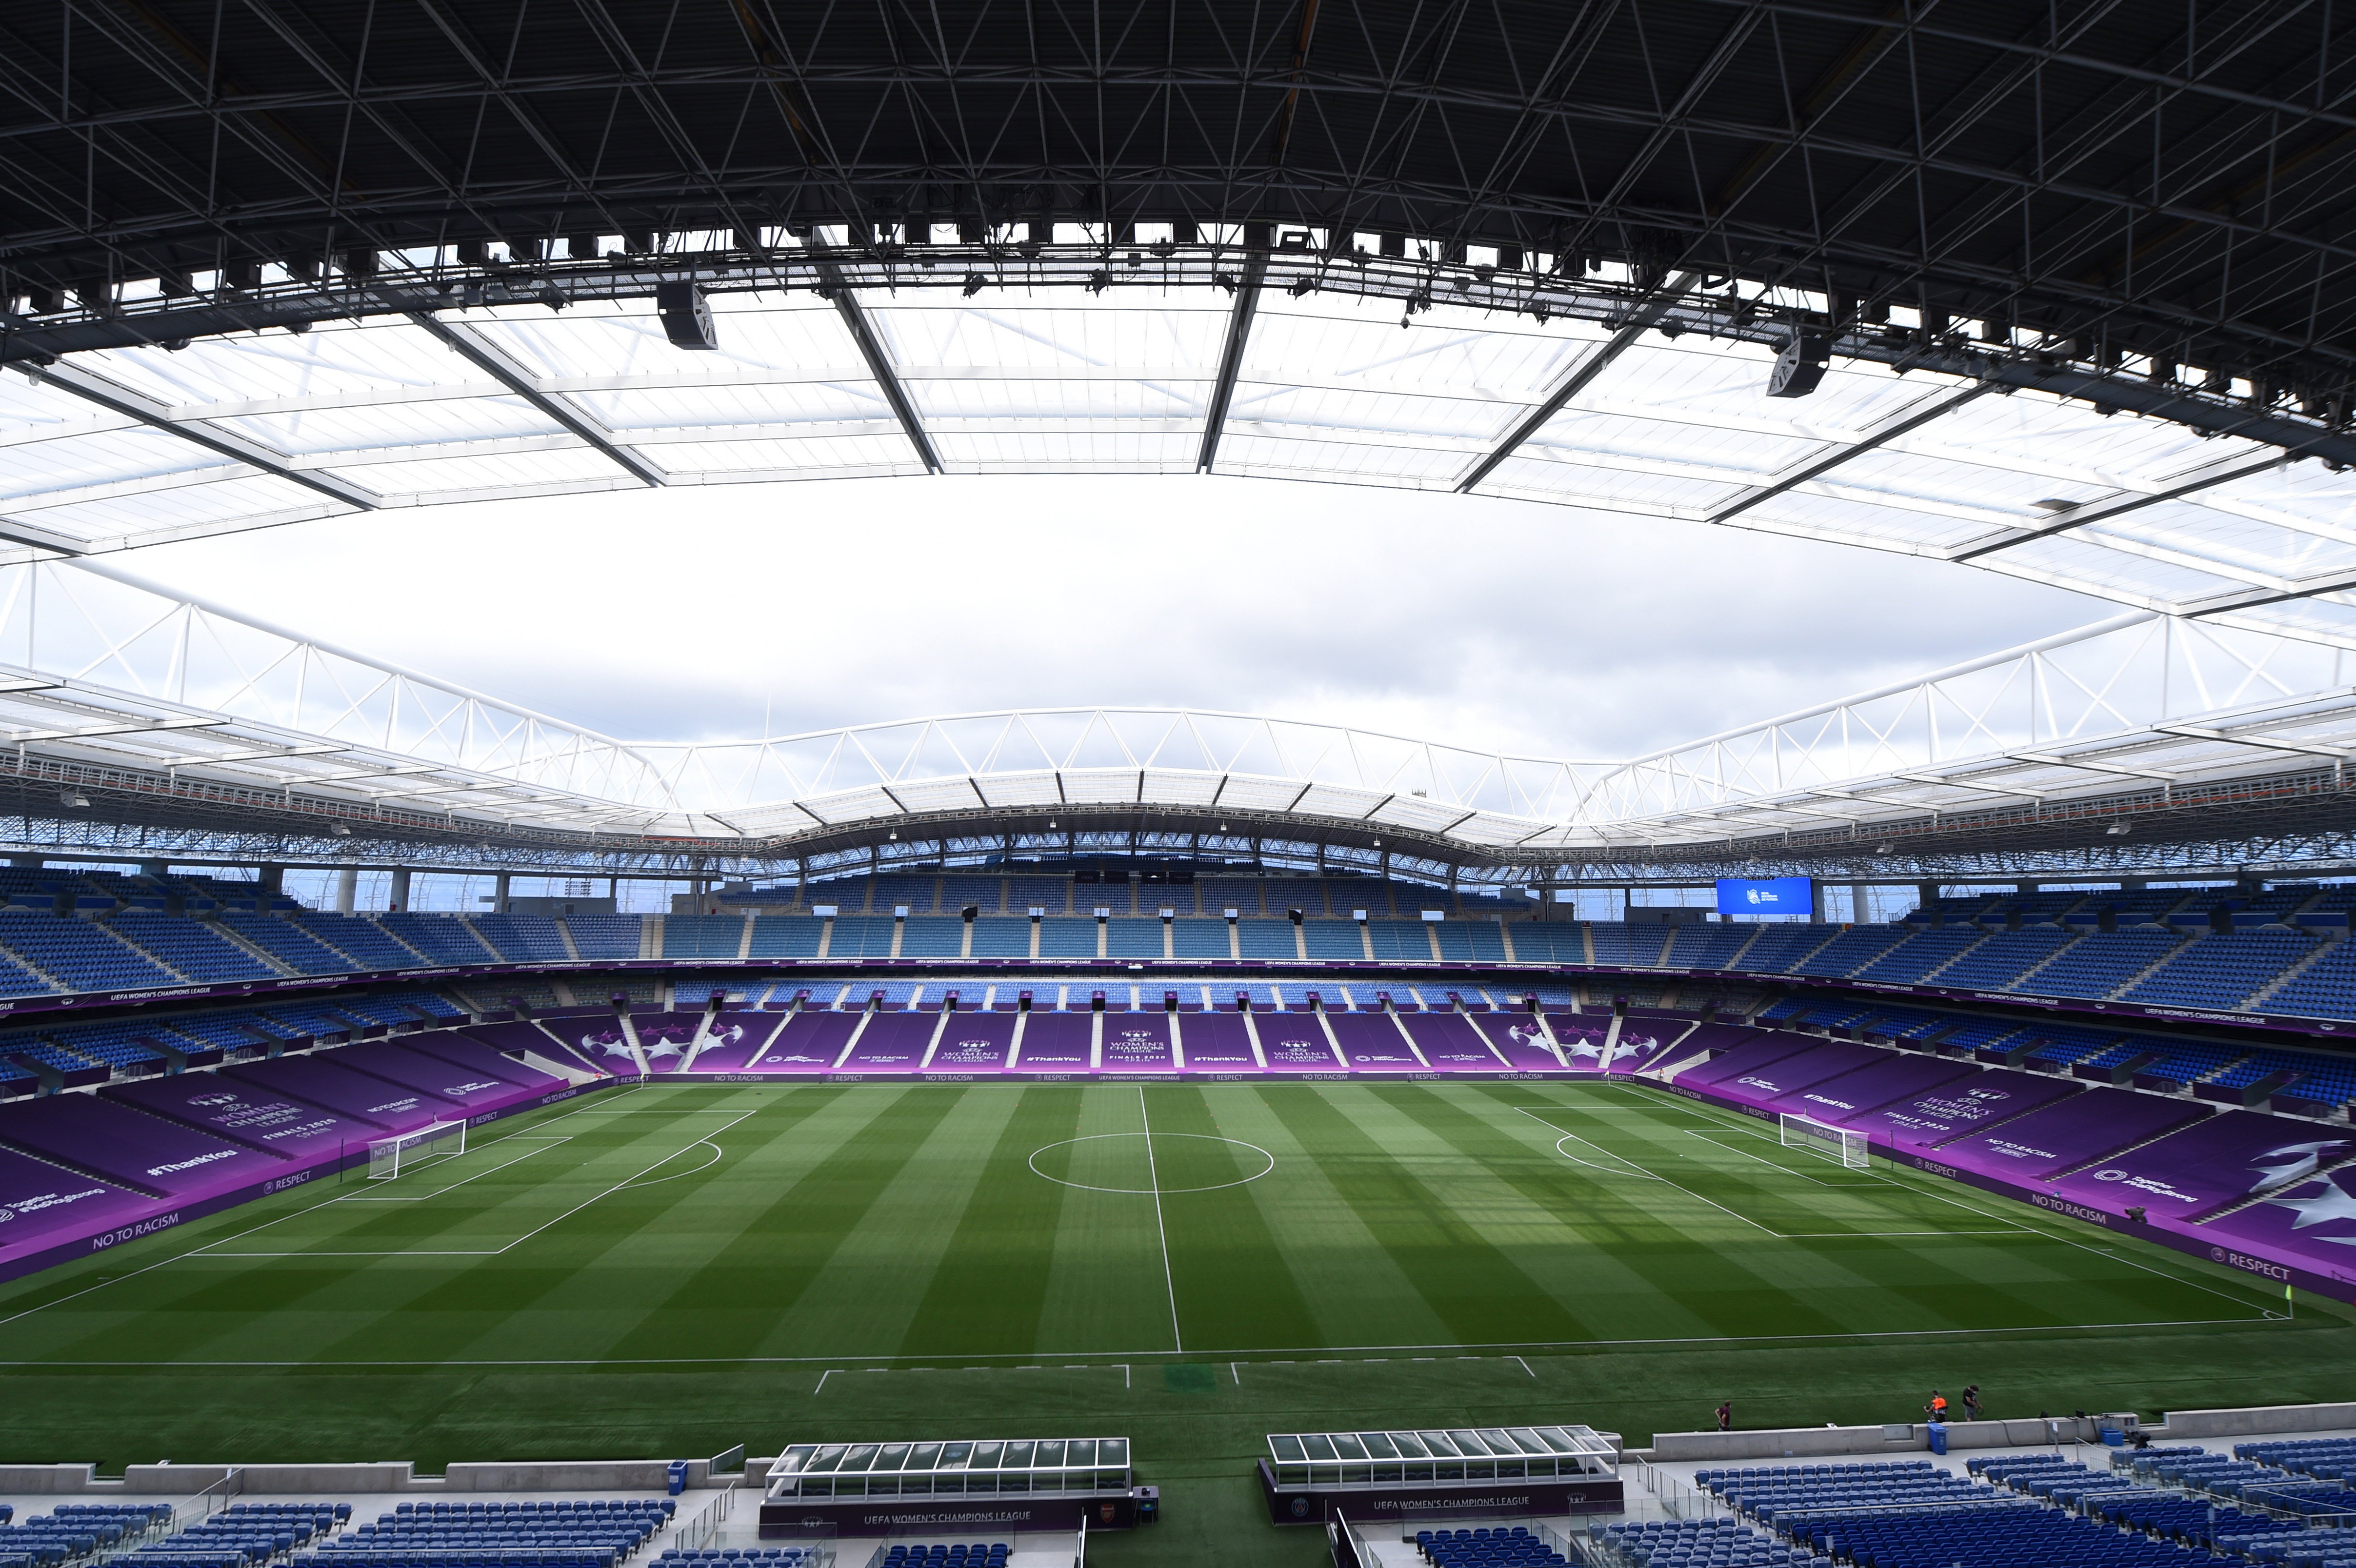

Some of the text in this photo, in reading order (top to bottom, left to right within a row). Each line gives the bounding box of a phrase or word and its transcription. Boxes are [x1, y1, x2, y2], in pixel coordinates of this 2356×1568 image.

[2163, 1009, 2194, 1018] WOMEN'S
[2195, 1012, 2236, 1022] CHAMPIONS
[2237, 1015, 2266, 1024] LEAGUE
[542, 1096, 550, 1104] NO
[559, 1088, 576, 1099] RACISM
[1669, 1085, 1700, 1100] NO TO RACISM
[1803, 1094, 1855, 1110] #ThankYou
[1926, 1097, 1994, 1116] WOMEN'S
[210, 1102, 290, 1122] WOMEN'S
[226, 1107, 303, 1127] CHAMPIONS
[476, 1111, 497, 1125] RESPECT
[1749, 1107, 1769, 1119] RESPECT
[1913, 1101, 1982, 1120] CHAMPIONS
[1917, 1109, 1955, 1120] LEAGUE
[262, 1118, 337, 1140] FINALS 2020
[1883, 1112, 1950, 1131] FINALS 2020
[1889, 1120, 1922, 1130] SPAIN
[297, 1127, 332, 1138] SPAIN
[1814, 1127, 1823, 1136] NO
[1823, 1130, 1832, 1139] TO
[2000, 1149, 2025, 1157] RESPECT
[2015, 1146, 2057, 1158] RACISM
[147, 1149, 238, 1176] #ThankYou
[1925, 1159, 1957, 1179] RESPECT
[276, 1170, 311, 1190] RESPECT
[2132, 1176, 2176, 1189] Together
[2033, 1193, 2105, 1224] NO TO RACISM
[93, 1213, 178, 1249] NO TO RACISM
[2229, 1252, 2290, 1281] RESPECT
[1374, 1496, 1529, 1510] UEFA WOMEN'S CHAMPIONS LEAGUE
[864, 1510, 1030, 1525] UEFA WOMEN'S CHAMPIONS LEAGUE
